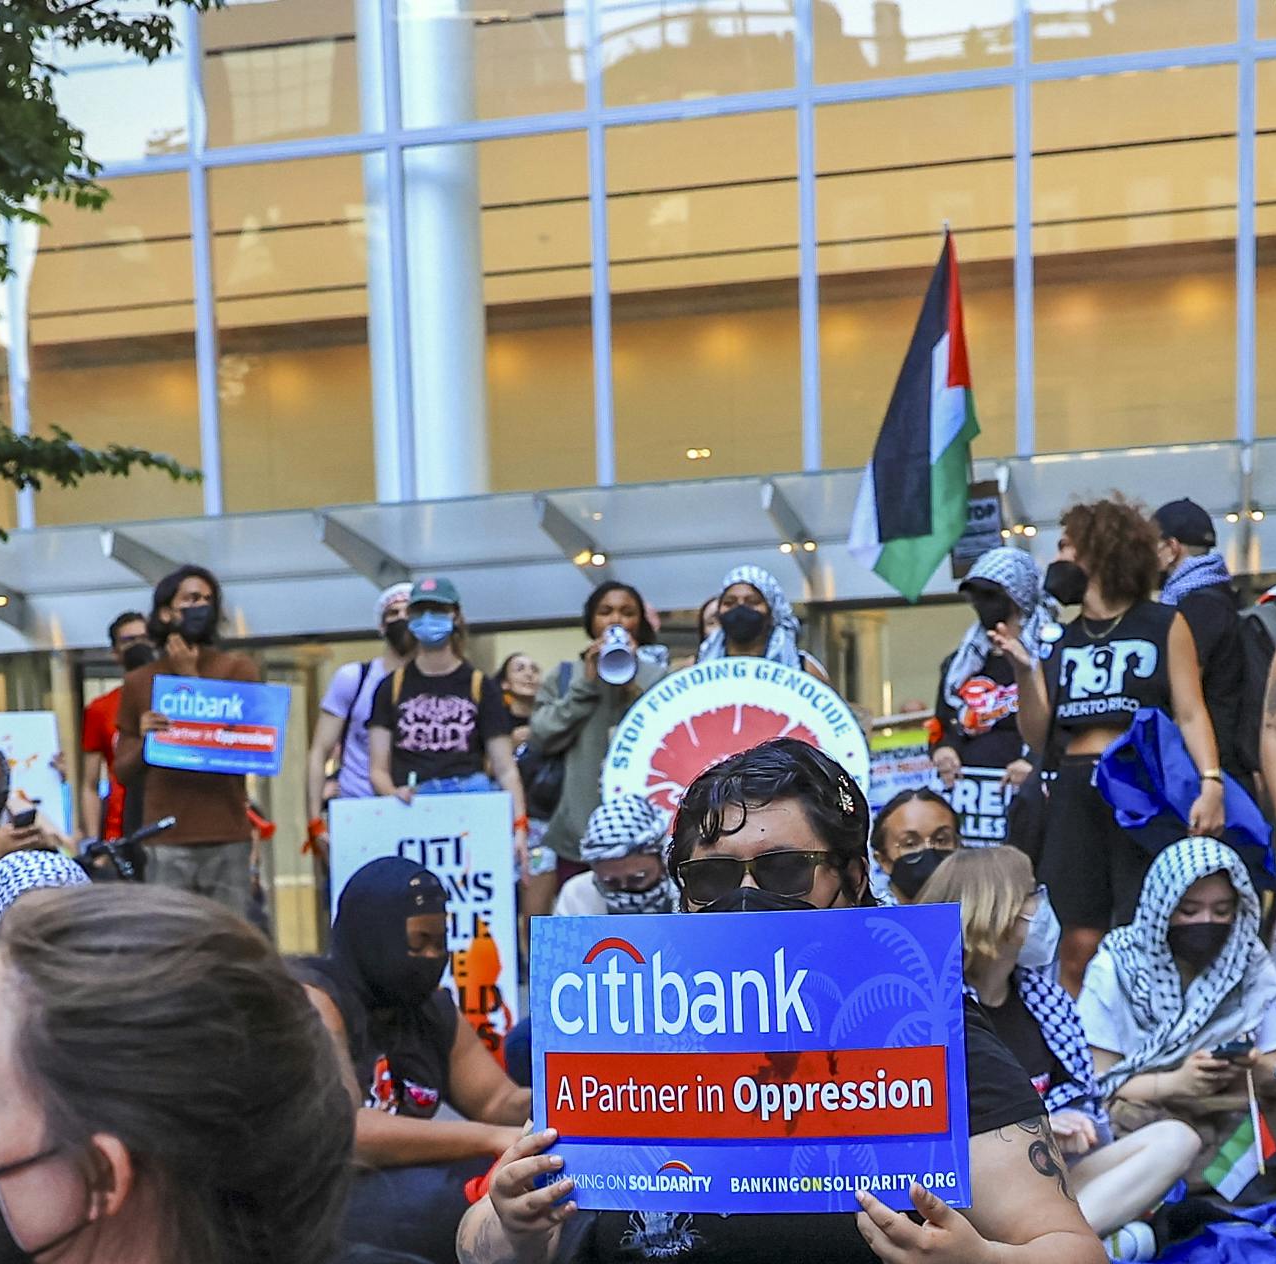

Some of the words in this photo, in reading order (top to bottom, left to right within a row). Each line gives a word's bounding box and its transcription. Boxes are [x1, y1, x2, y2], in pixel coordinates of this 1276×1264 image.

[160, 690, 244, 720] citibank
[613, 712, 646, 770] STOP
[649, 661, 747, 713] FUNDING
[755, 663, 853, 739] GENOCIDE
[398, 837, 461, 867] CITI
[550, 947, 813, 1035] citibank
[556, 1076, 575, 1111] A
[582, 1075, 689, 1113] Partner
[697, 1074, 724, 1112] in
[733, 1069, 933, 1121] Oppression
[606, 1174, 626, 1190] ON
[628, 1175, 712, 1192] SOLIDARITY
[730, 1171, 957, 1193] BANKINGONSOLIDARITYORG
